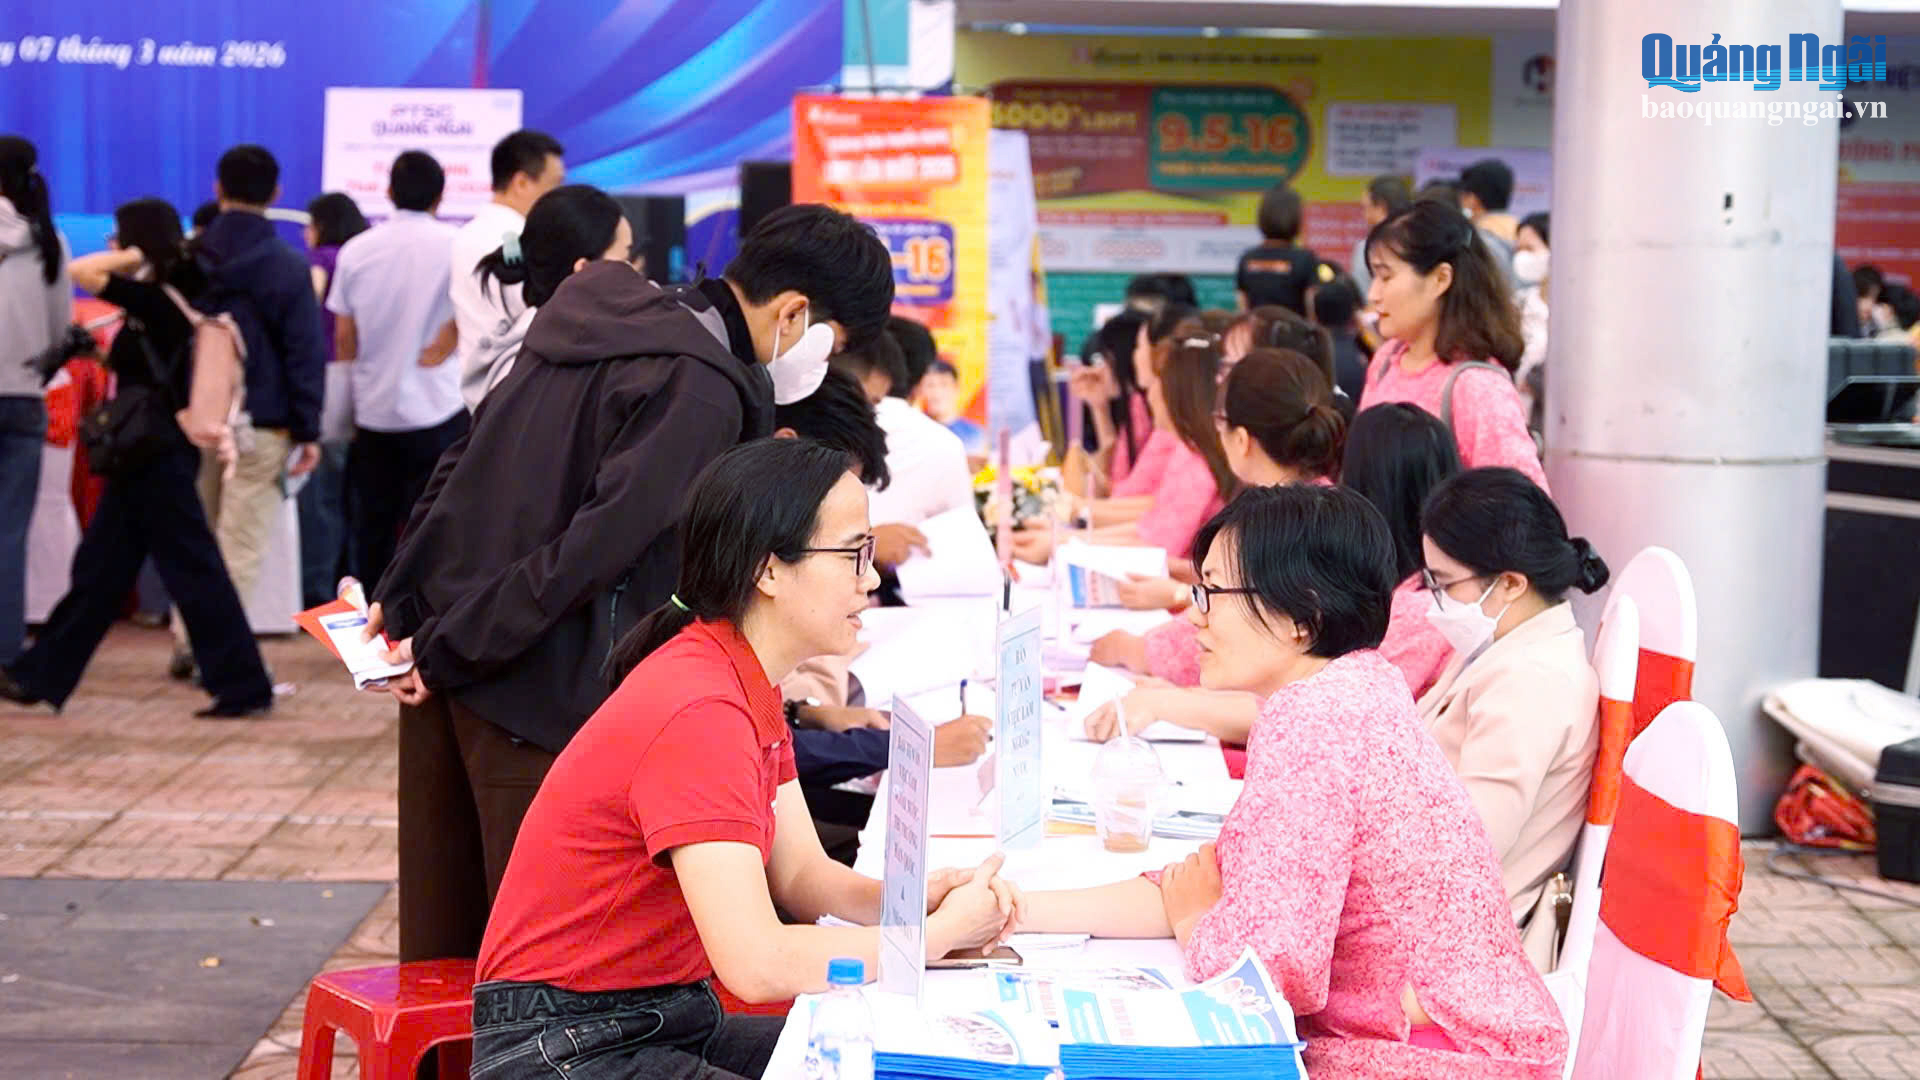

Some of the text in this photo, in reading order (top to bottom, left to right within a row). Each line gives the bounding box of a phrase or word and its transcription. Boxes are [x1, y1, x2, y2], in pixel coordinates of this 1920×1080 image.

[19, 36, 56, 62] 07
[57, 33, 133, 70] tháng
[137, 38, 156, 65] 3
[158, 41, 217, 66] năm
[220, 40, 286, 68] 2026
[1157, 112, 1299, 155] 9.5-16
